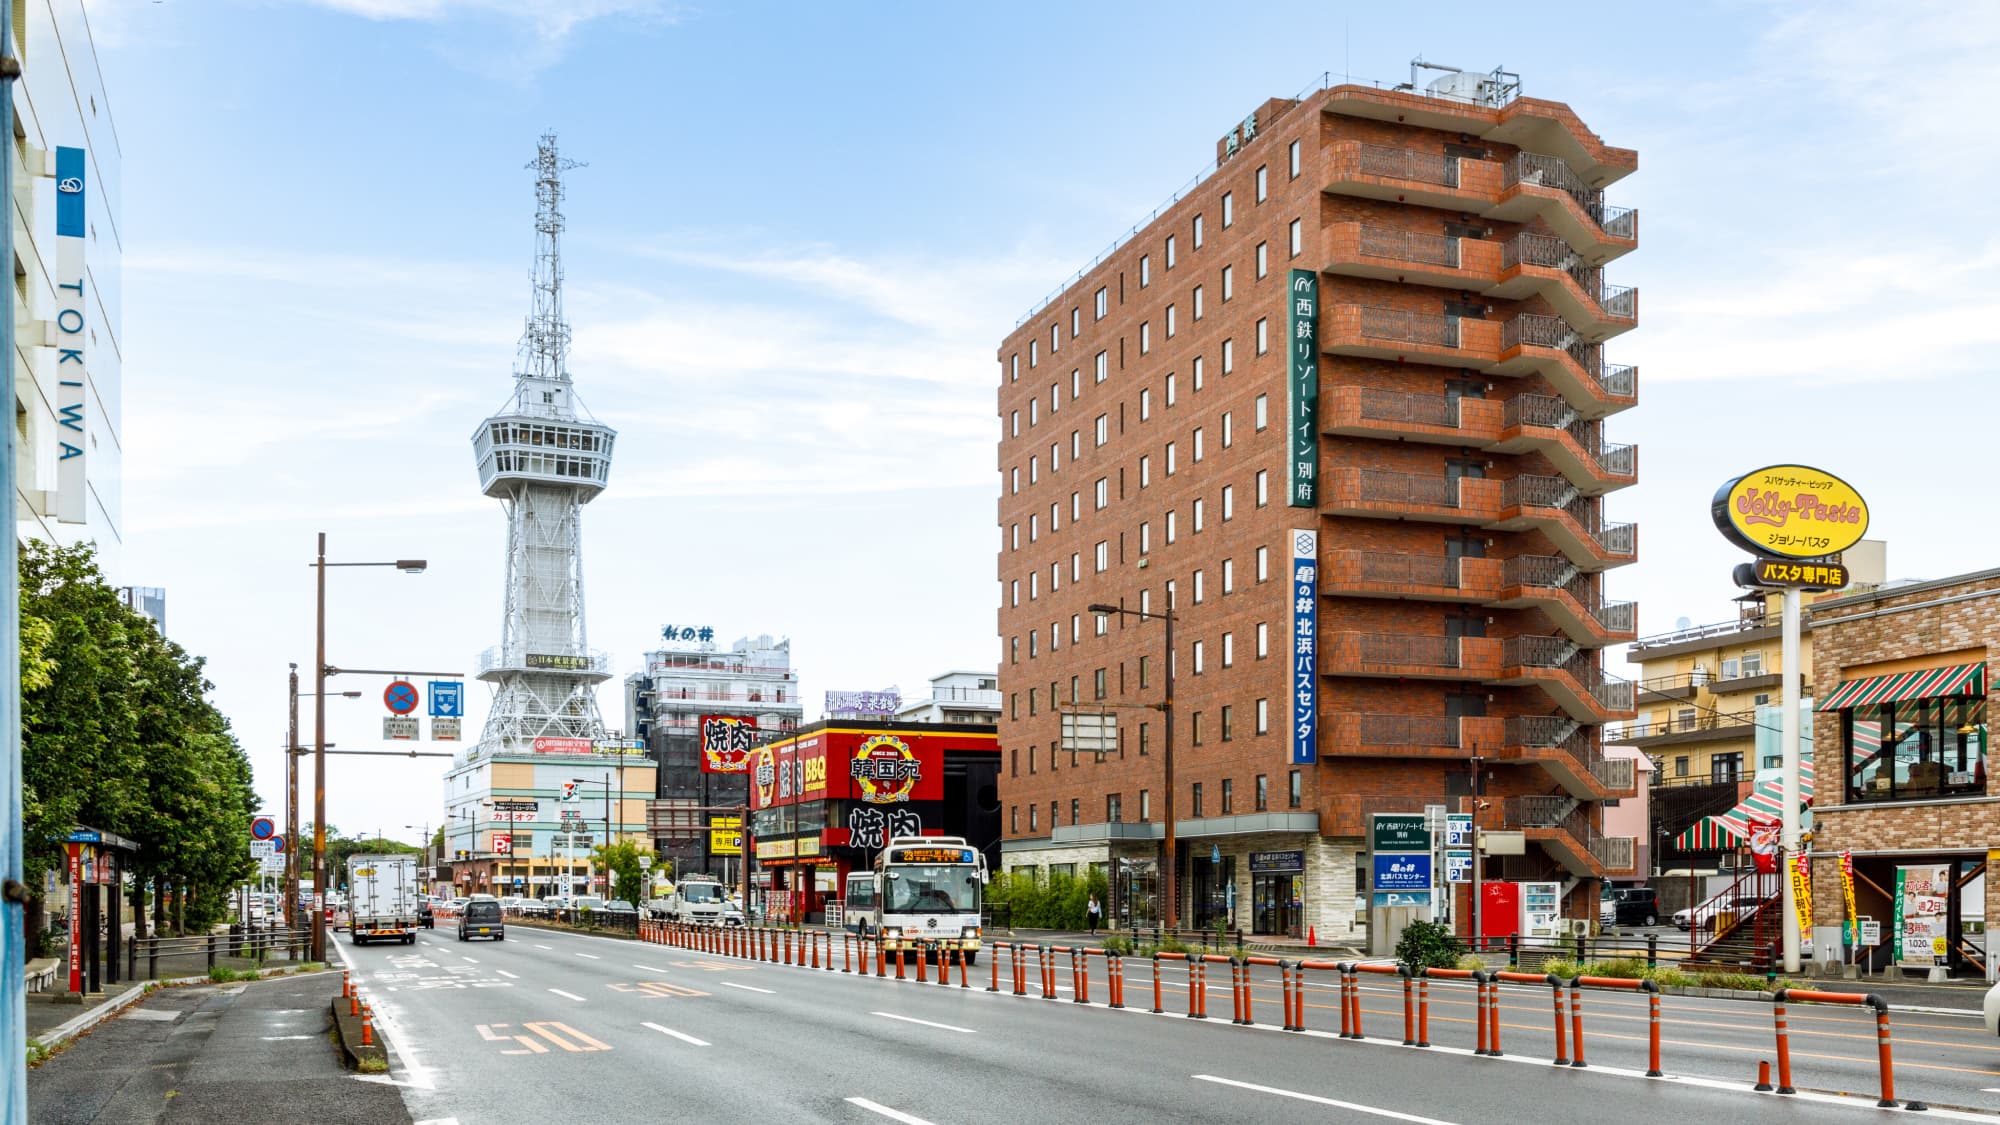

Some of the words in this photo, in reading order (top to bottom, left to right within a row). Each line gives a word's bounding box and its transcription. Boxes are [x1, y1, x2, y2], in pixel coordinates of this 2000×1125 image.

[58, 278, 85, 461] TOKIWA
[1296, 298, 1314, 500] 西鉄リゾートイン別府
[1768, 534, 1830, 548] ジョリーパスタ
[1764, 563, 1842, 585] パスタ専門店
[704, 719, 753, 753] 焼肉
[805, 755, 826, 782] BBQ
[851, 758, 922, 781] 韓国苑
[493, 813, 536, 821] カラオケ
[850, 807, 921, 849] 焼肉
[1387, 893, 1400, 906] P
[474, 1021, 614, 1055] 50
